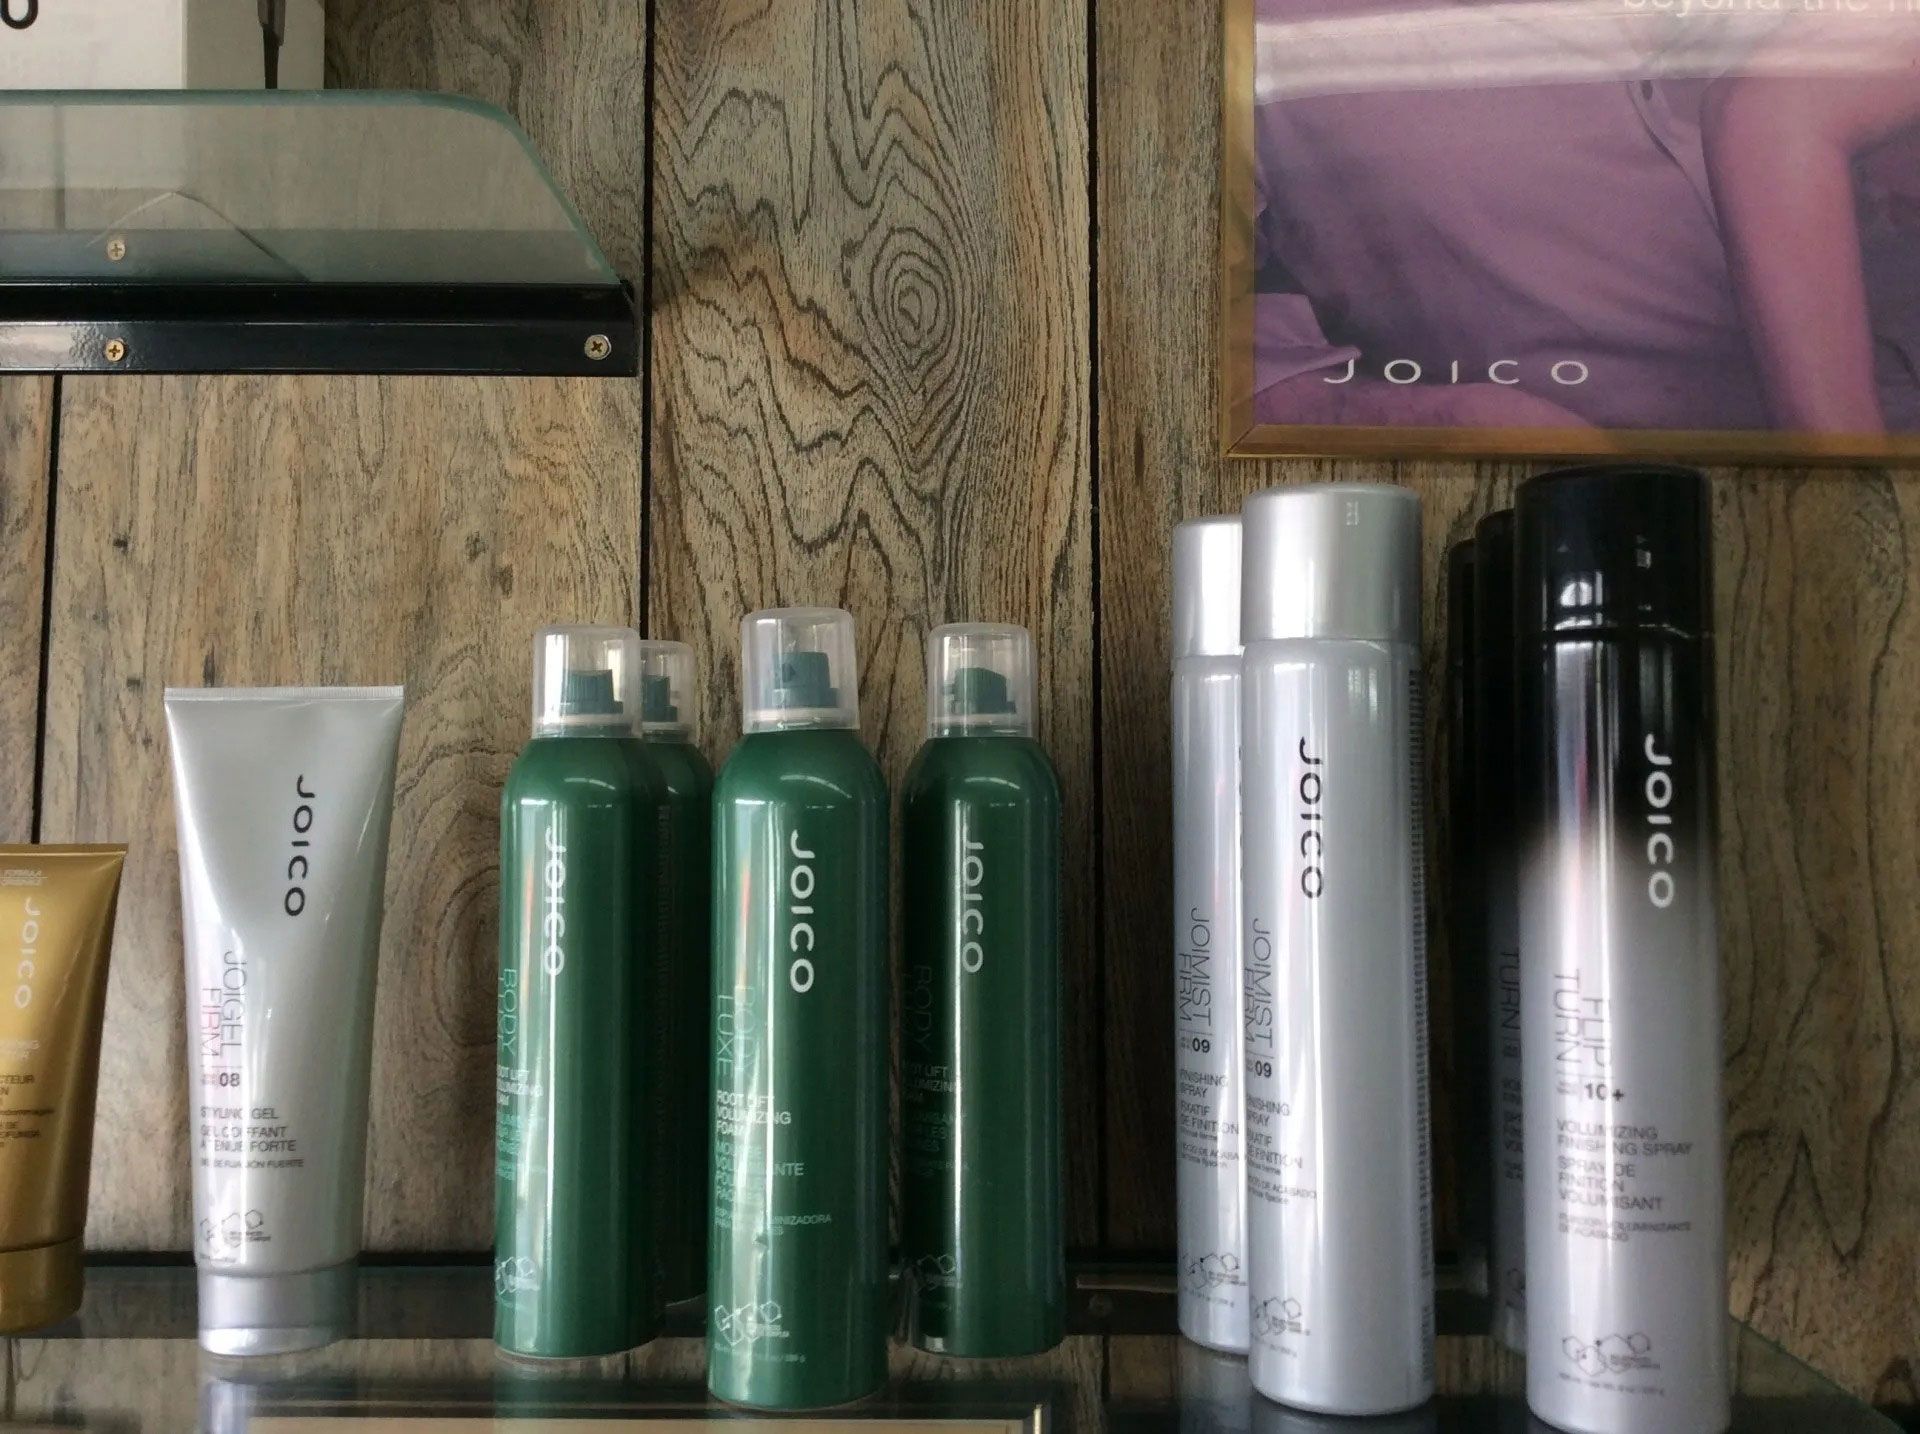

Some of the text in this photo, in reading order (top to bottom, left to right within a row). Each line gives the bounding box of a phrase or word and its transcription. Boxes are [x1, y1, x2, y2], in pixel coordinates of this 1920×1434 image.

[1322, 359, 1590, 386] JOICO
[284, 774, 316, 917] JOICO
[1300, 736, 1322, 899] JOICO
[1645, 733, 1675, 909] JOICO
[545, 826, 567, 977] JOICO
[790, 829, 815, 993] JOICO
[961, 827, 984, 973] JOICO
[13, 896, 41, 1010] JOICO
[220, 950, 248, 1058] JOIGEL
[1179, 952, 1193, 1022] FIRM
[1190, 907, 1211, 1027] JOIMIST
[1252, 917, 1273, 1049] JOIMIST
[201, 987, 222, 1058] FIRM
[1192, 1037, 1211, 1053] 09
[1244, 966, 1256, 1044] FIRM
[1553, 968, 1582, 1064] TURN
[219, 1072, 241, 1088] 08
[251, 1107, 280, 1121] GEL
[1255, 1060, 1272, 1078] 09
[249, 1140, 297, 1152] FORTE
